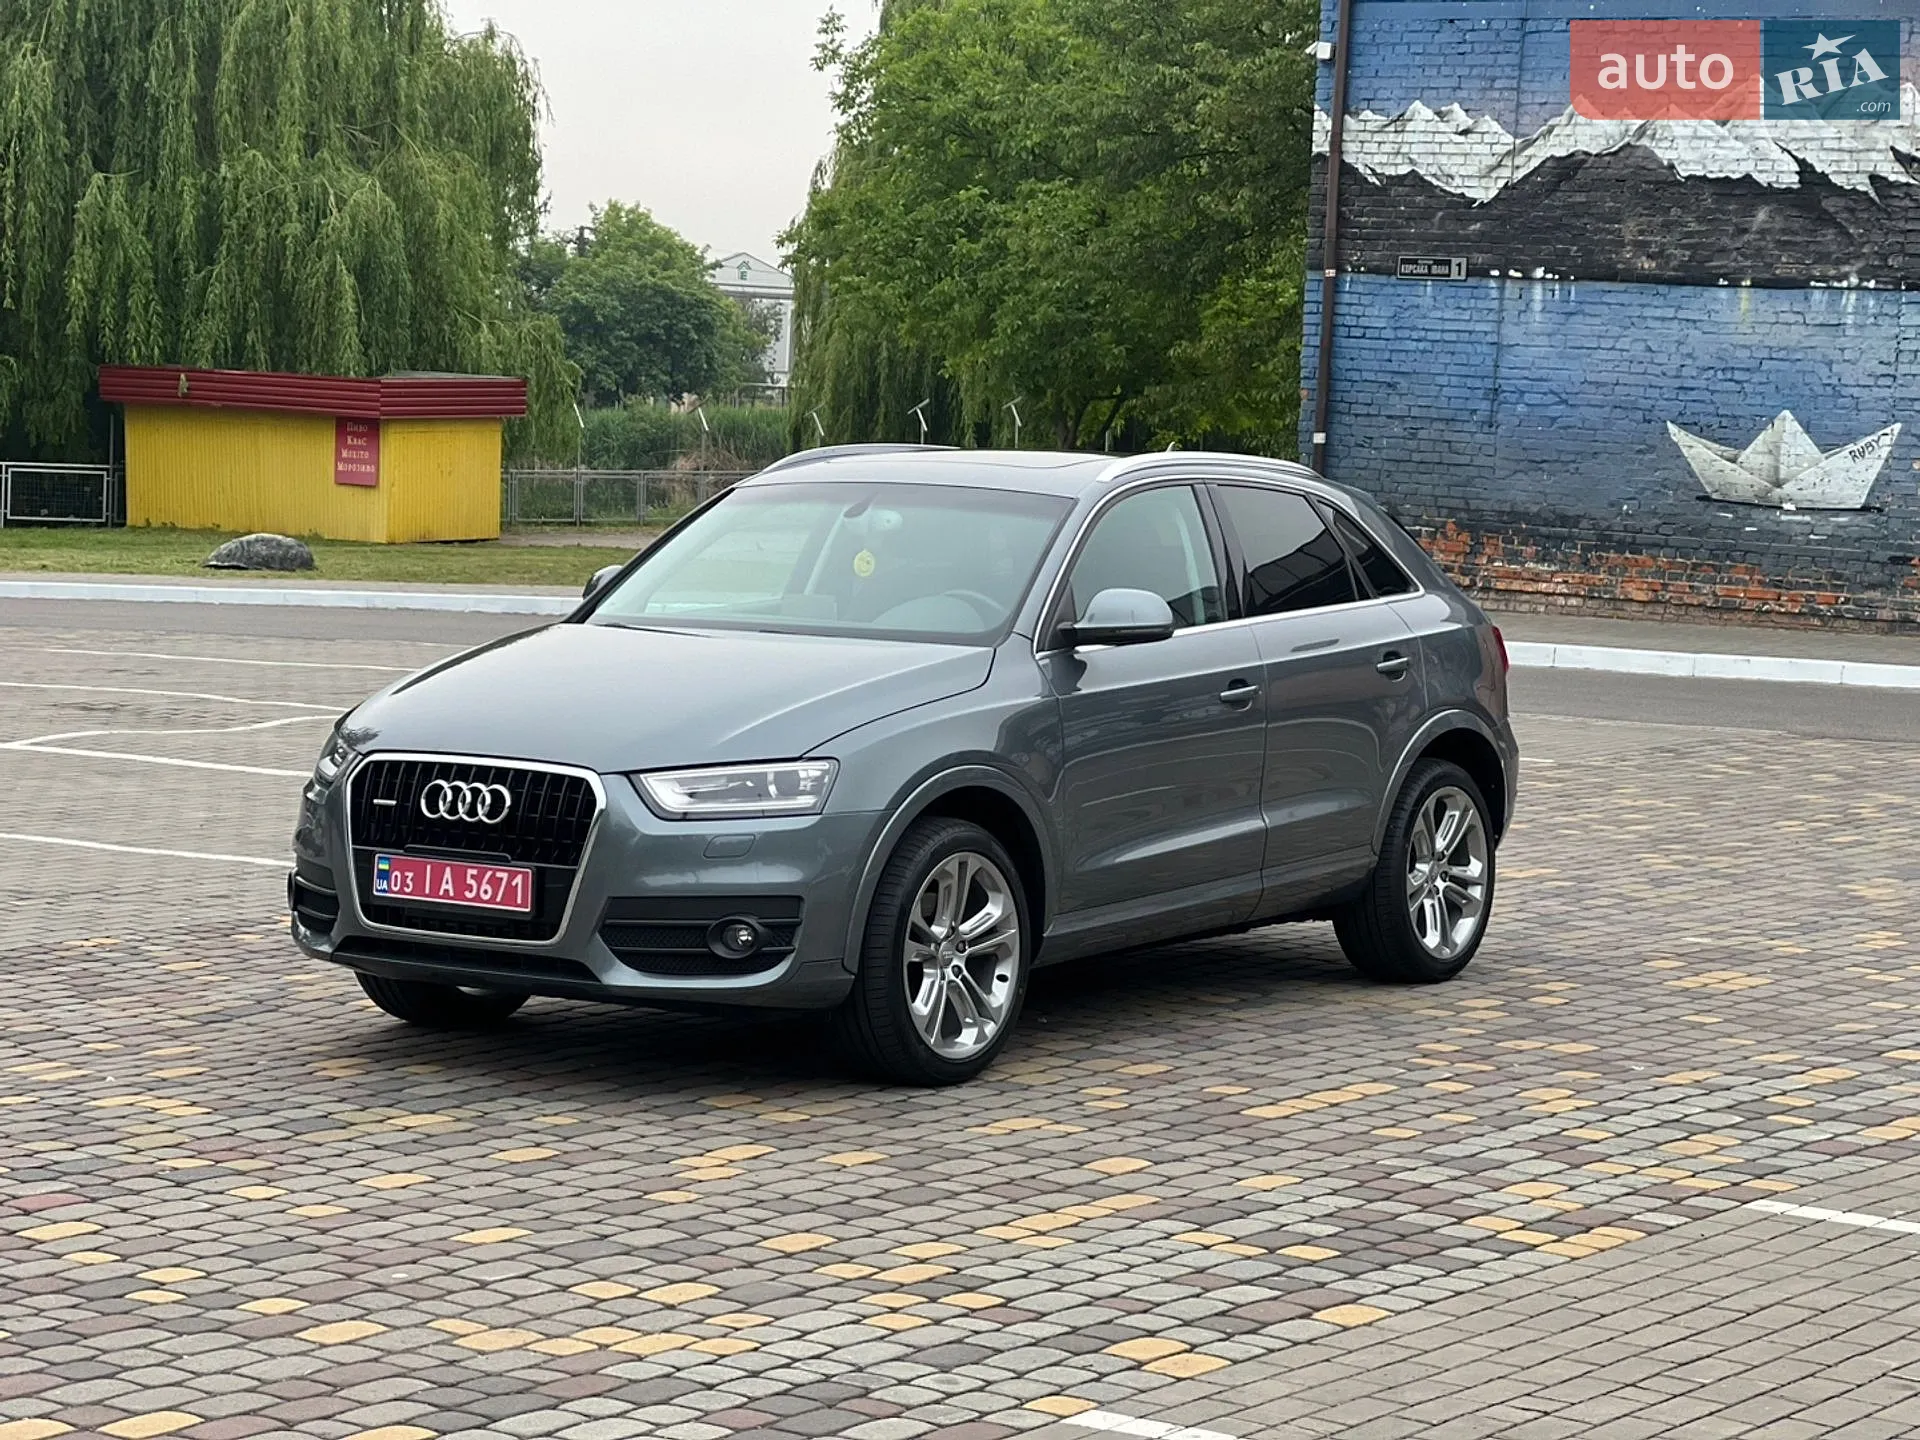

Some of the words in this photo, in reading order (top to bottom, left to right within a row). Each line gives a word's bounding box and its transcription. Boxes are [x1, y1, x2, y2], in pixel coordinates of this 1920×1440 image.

[1455, 261, 1462, 277] 1
[376, 878, 388, 891] UA
[390, 870, 414, 893] 03
[425, 864, 454, 897] IA
[463, 869, 523, 904] 5671
